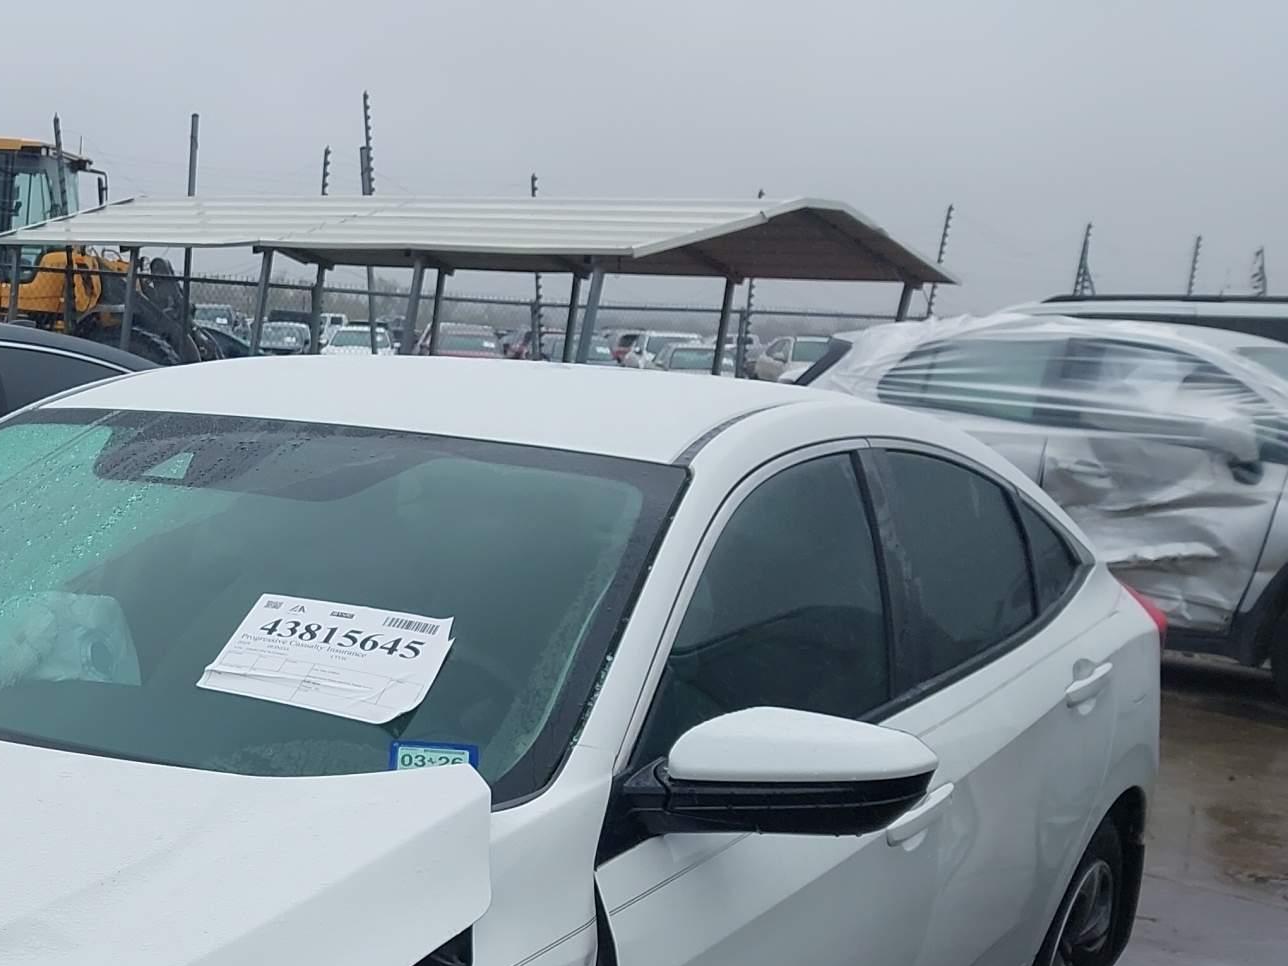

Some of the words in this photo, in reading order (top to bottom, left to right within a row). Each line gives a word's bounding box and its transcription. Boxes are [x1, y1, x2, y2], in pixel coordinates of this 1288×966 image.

[241, 633, 286, 645] Progressive
[289, 639, 325, 651] Casualty
[326, 645, 367, 659] Insurance
[259, 618, 426, 660] 43815645
